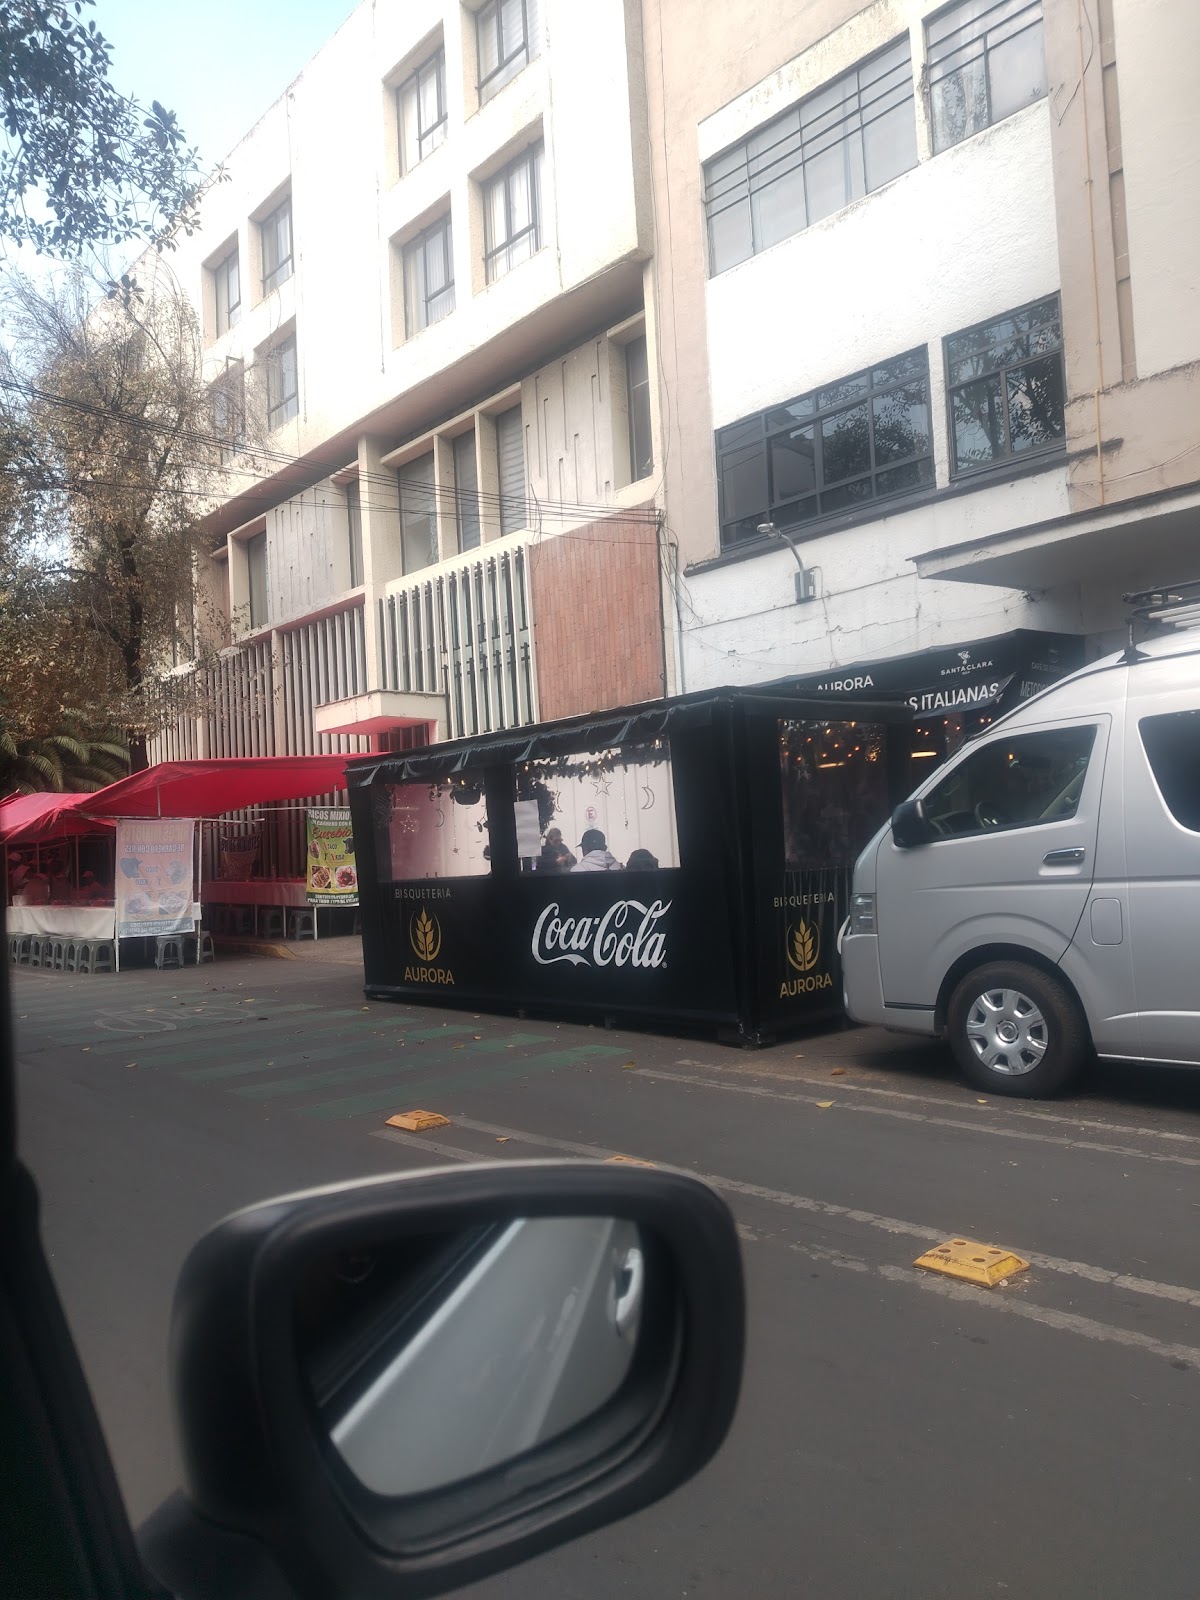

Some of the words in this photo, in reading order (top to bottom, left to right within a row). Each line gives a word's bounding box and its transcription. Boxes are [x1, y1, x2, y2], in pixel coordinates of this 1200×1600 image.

[921, 682, 999, 711] ITALIANAS
[307, 809, 329, 820] RICOS
[329, 810, 352, 820] MIXIO
[312, 826, 352, 839] Eusebio
[394, 887, 452, 900] BISQUETERIA
[773, 892, 835, 908] BISQUETERIA
[531, 898, 673, 970] Coca-Cola
[404, 966, 455, 985] AURORA
[779, 972, 833, 999] AURORA
